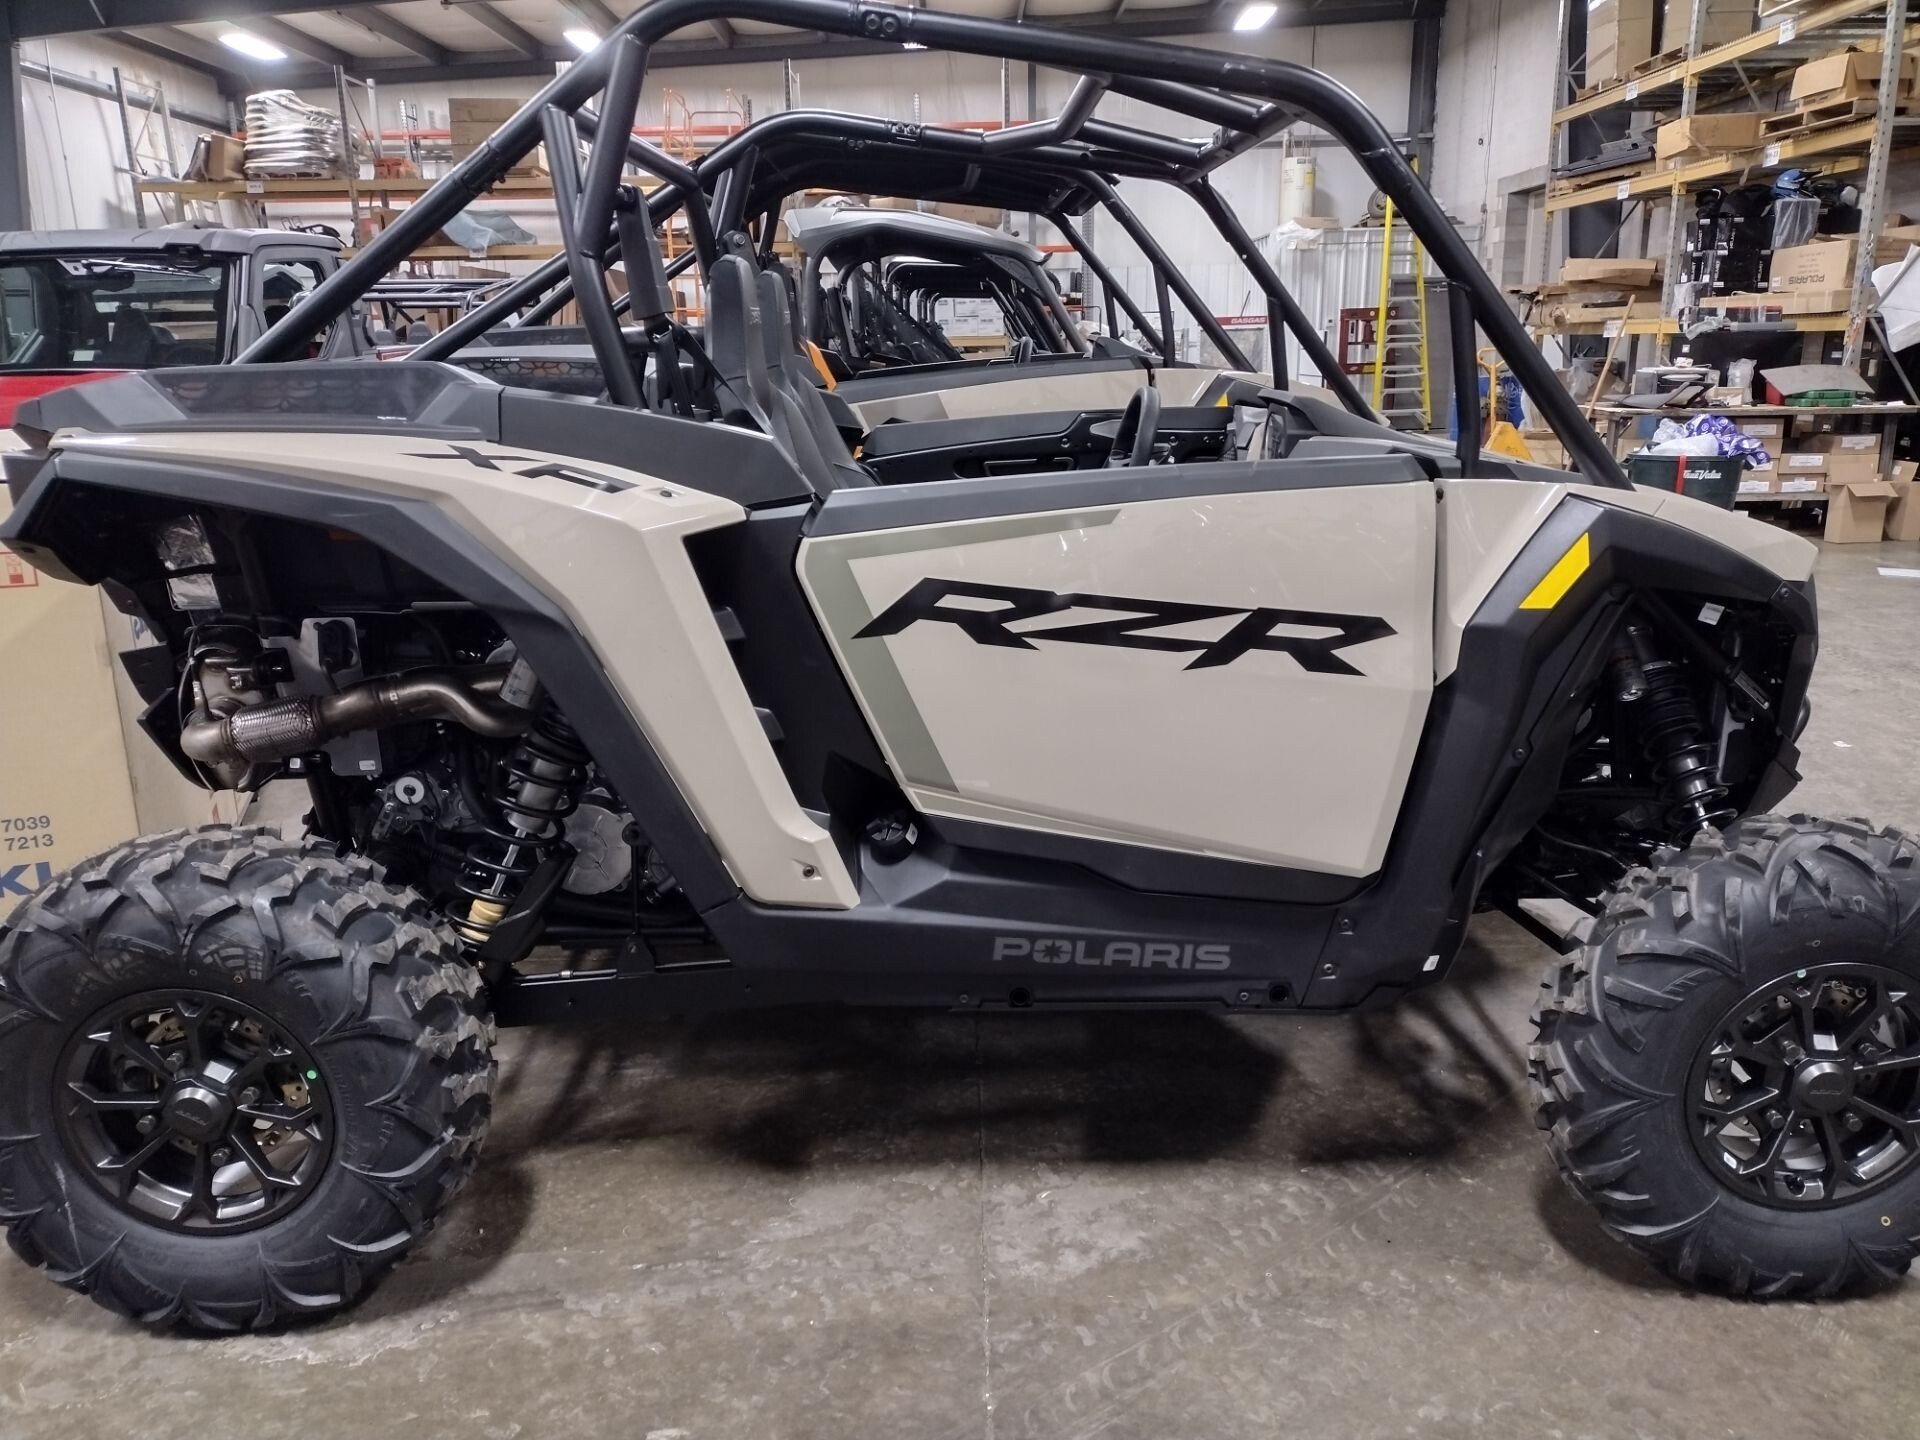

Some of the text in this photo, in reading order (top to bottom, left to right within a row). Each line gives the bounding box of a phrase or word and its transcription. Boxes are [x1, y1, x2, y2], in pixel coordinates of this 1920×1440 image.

[1788, 274, 1826, 285] POLARIS
[851, 577, 1399, 677] RZR
[0, 815, 51, 833] 7039
[3, 834, 54, 851] 7213
[992, 936, 1232, 971] POLARIS
